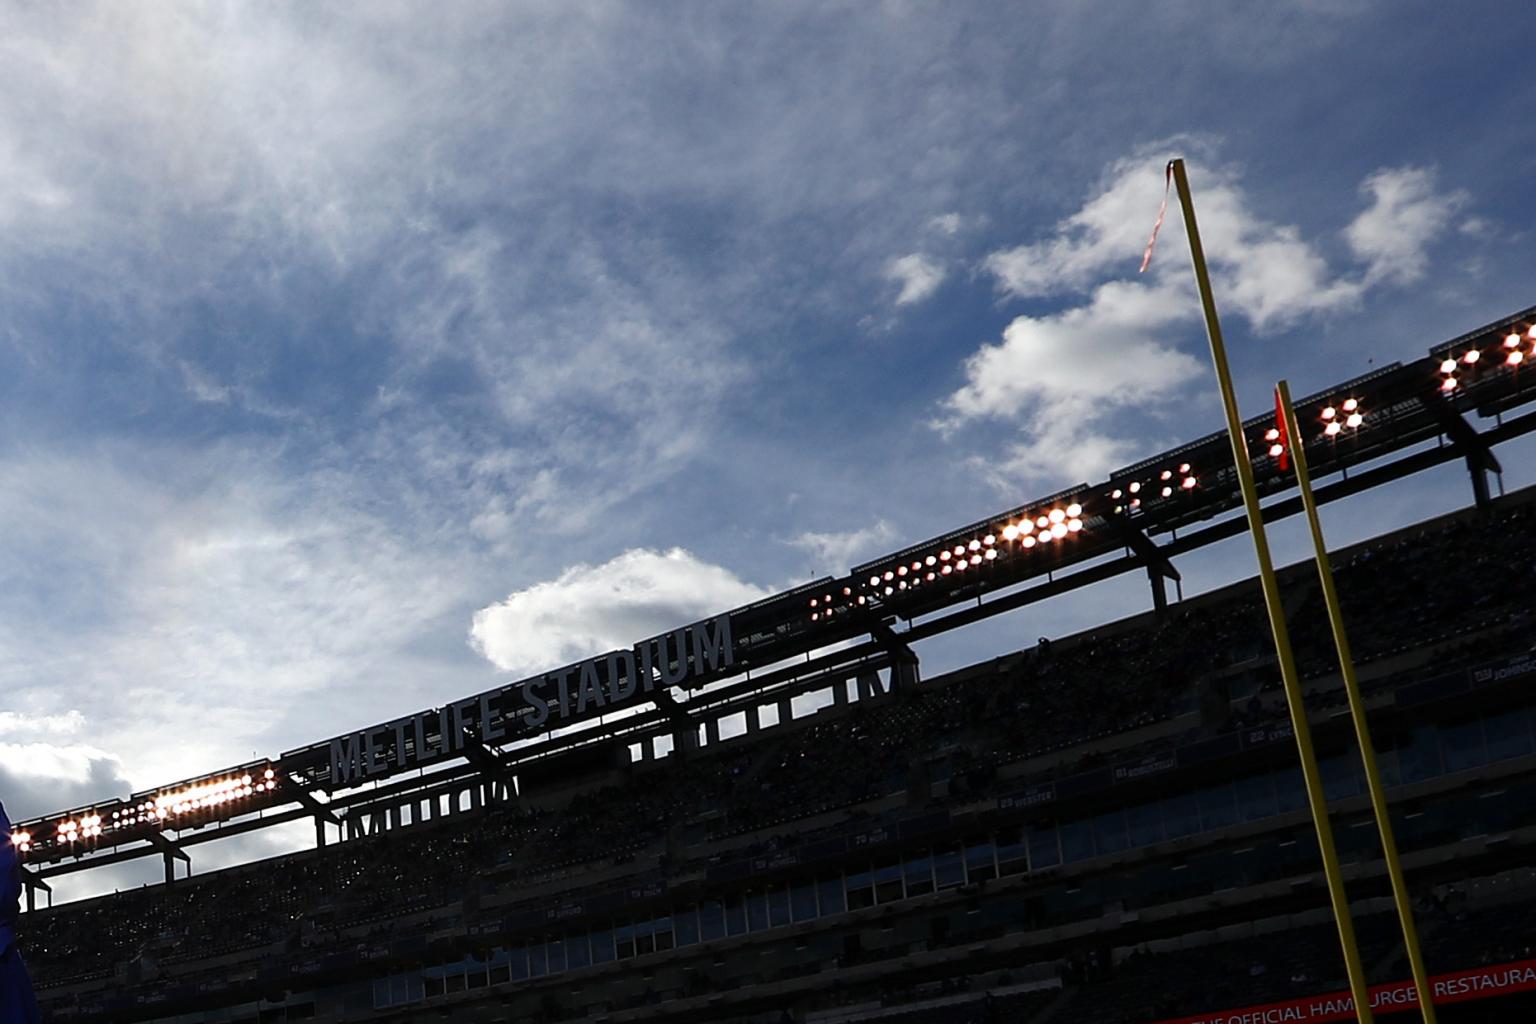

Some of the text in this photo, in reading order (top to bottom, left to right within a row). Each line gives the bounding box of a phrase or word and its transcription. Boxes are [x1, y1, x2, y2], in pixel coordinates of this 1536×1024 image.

[330, 690, 506, 785] METLIFE
[521, 614, 735, 727] STADIUM
[1310, 985, 1419, 1016] HAMURGE
